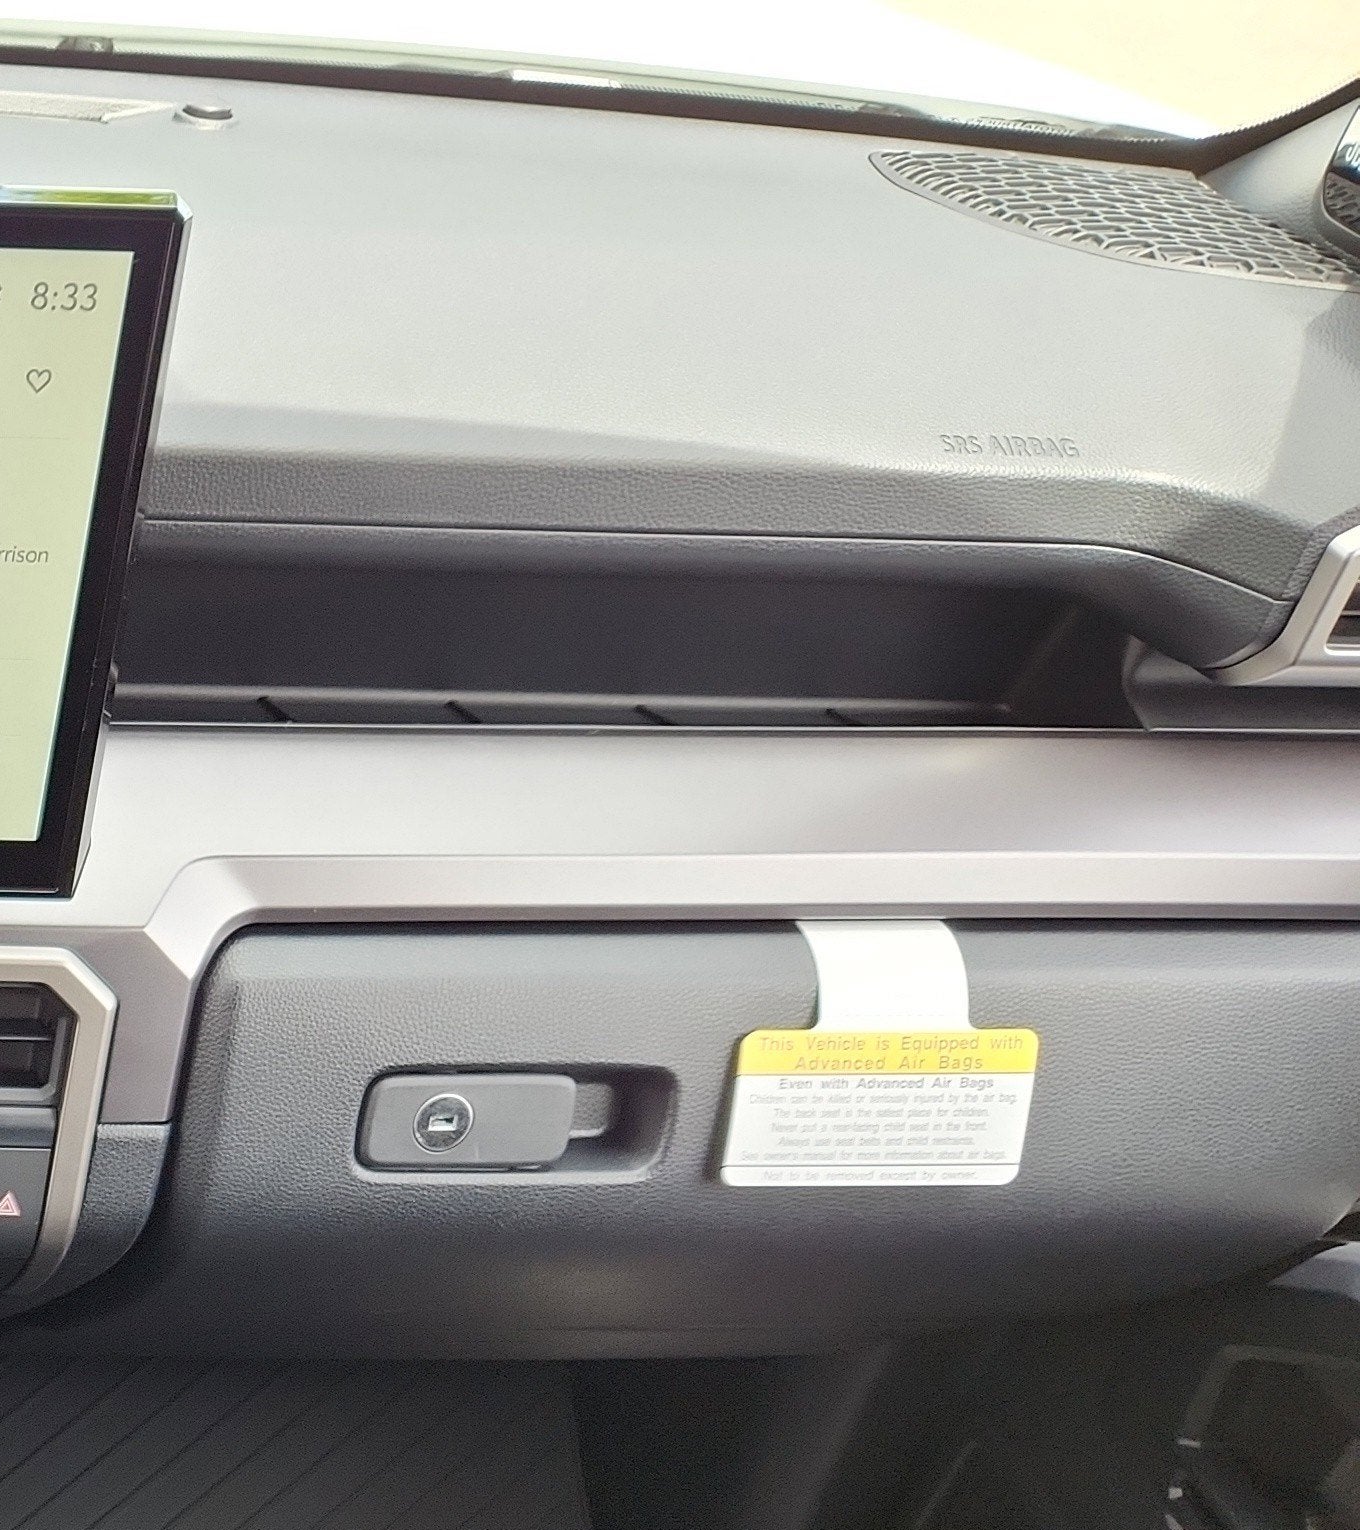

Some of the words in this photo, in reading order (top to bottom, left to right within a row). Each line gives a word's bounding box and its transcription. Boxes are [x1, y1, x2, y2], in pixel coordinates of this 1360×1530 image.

[30, 282, 98, 312] 8:33
[940, 434, 982, 455] SRS
[989, 435, 1080, 458] AIRBAG
[760, 1036, 794, 1051] This
[806, 1036, 866, 1051] Vehicle
[876, 1036, 890, 1050] is
[901, 1036, 979, 1053] Equipped
[990, 1034, 1023, 1049] with
[795, 1056, 886, 1071] Advanced
[898, 1056, 925, 1070] Air
[938, 1055, 983, 1071] Bags
[778, 1078, 812, 1089] Even
[821, 1077, 848, 1089] with
[856, 1077, 924, 1089] Advanced
[931, 1077, 952, 1088] Air
[959, 1077, 994, 1090] Bags
